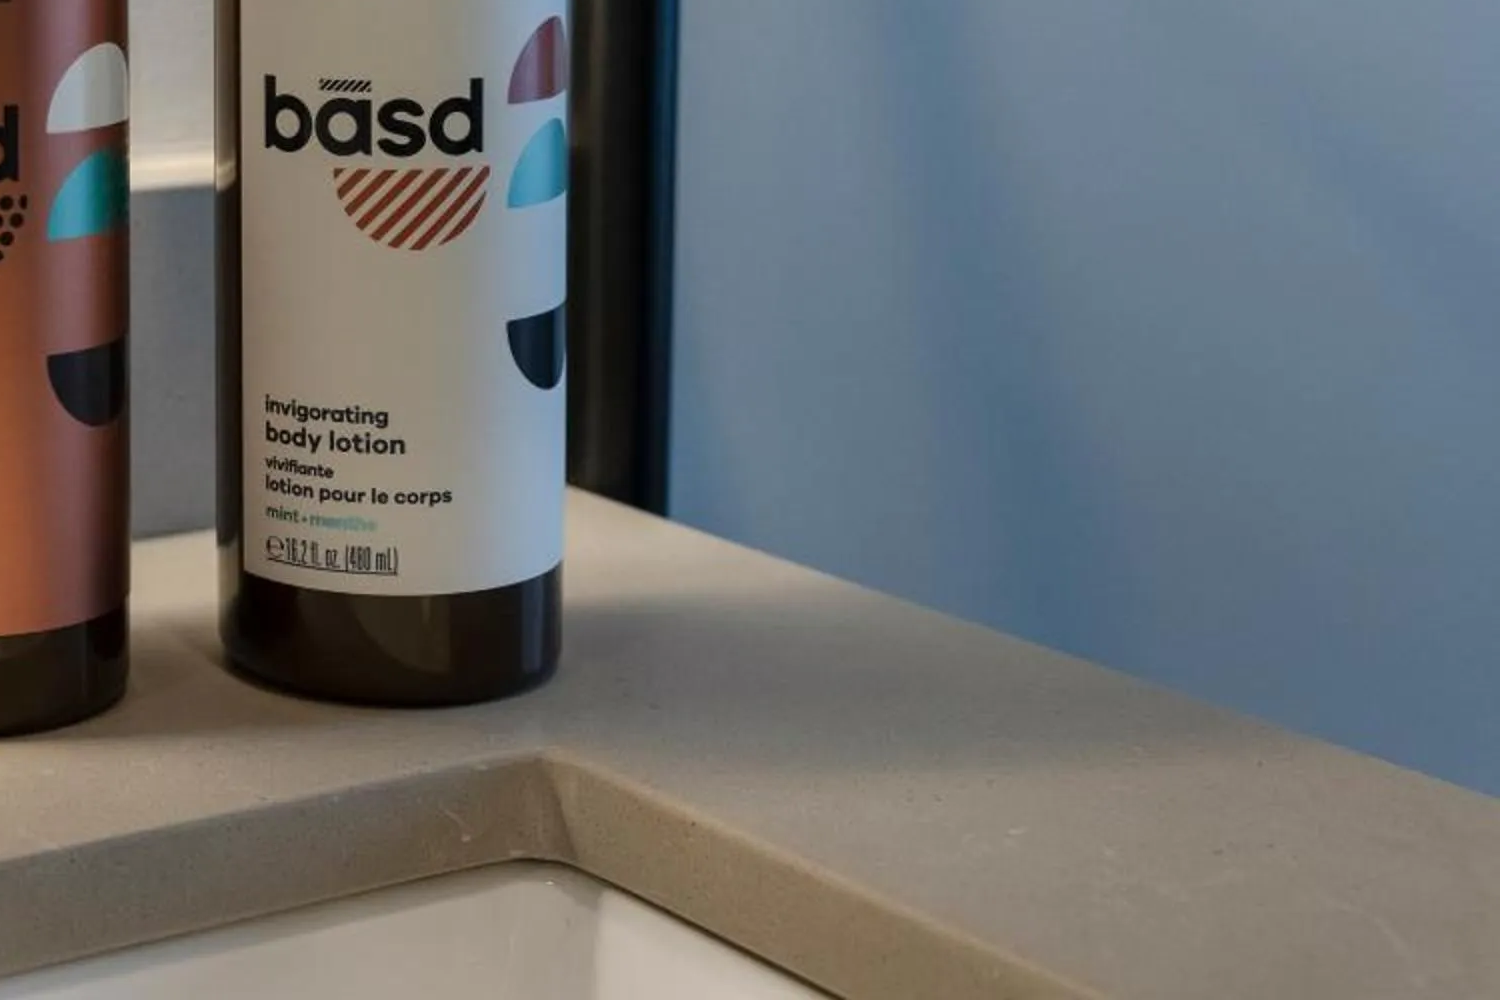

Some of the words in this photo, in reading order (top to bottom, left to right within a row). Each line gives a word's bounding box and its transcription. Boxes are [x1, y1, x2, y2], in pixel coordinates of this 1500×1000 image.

[265, 394, 389, 429] invigorating
[265, 422, 321, 453] body
[329, 430, 406, 455] lotion
[265, 455, 334, 479] vivifiante
[265, 476, 313, 499] lotion
[319, 489, 366, 505] pour
[371, 487, 389, 505] le
[394, 489, 453, 507] corps
[266, 505, 299, 523] mint
